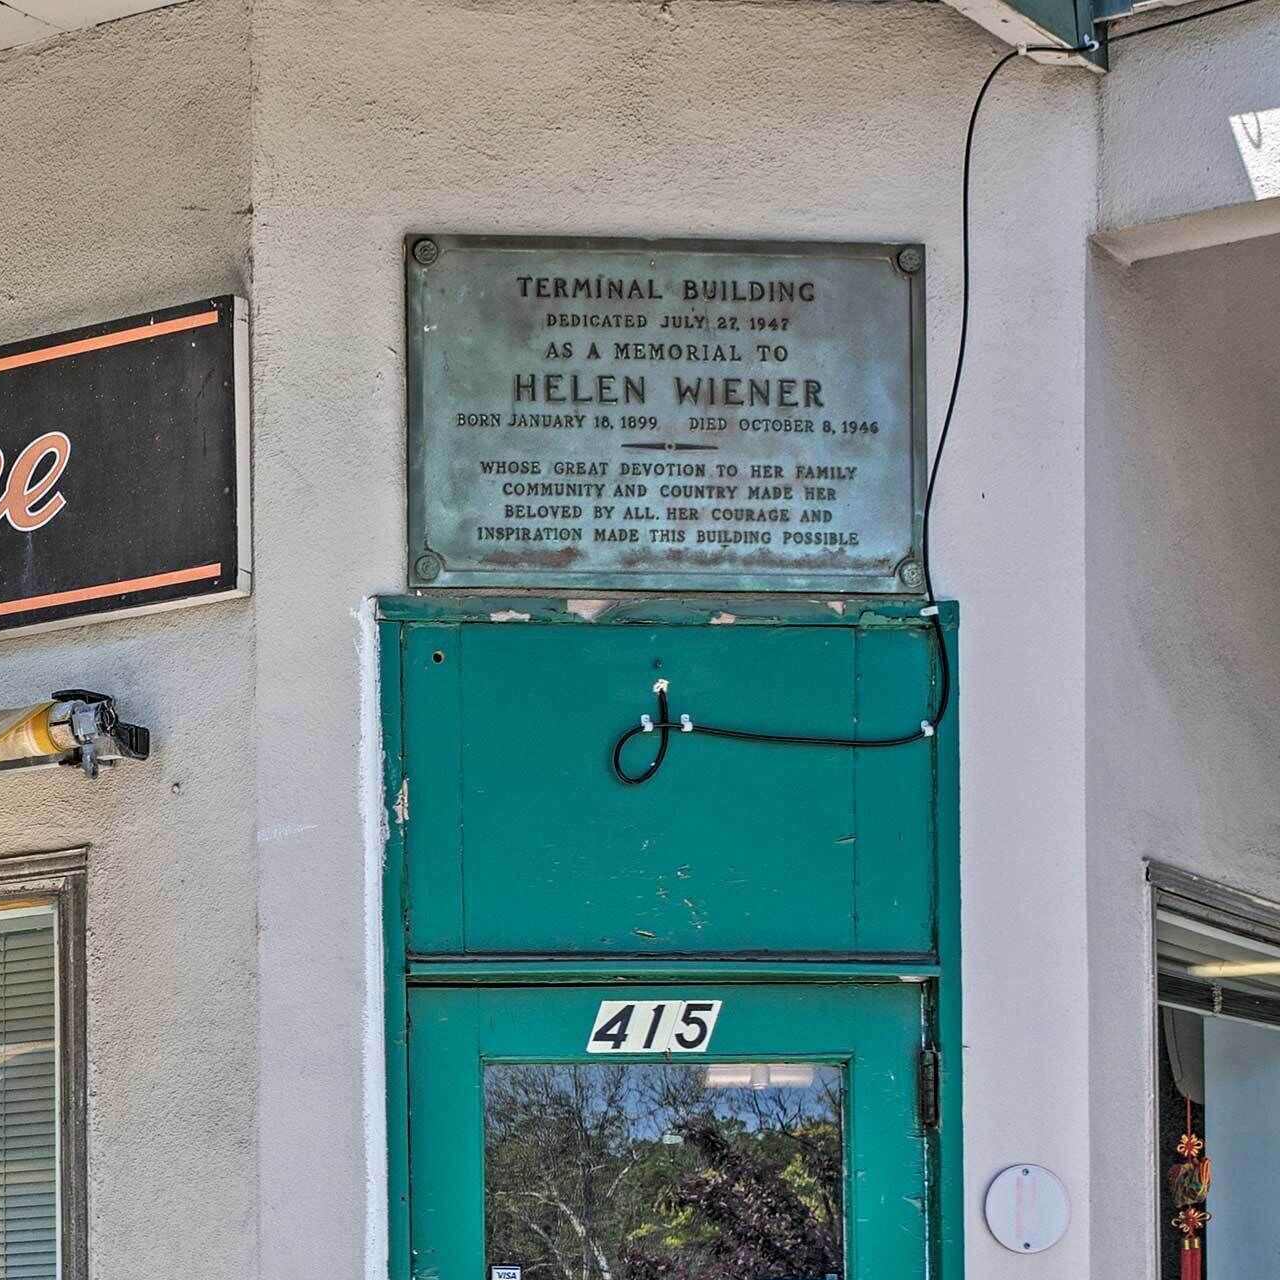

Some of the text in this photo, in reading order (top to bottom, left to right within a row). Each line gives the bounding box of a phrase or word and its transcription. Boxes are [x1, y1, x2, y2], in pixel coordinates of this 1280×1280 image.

[517, 277, 816, 302] TERMINAL BUILDING
[546, 314, 648, 328] DEDICATED
[659, 315, 705, 329] JULY
[750, 317, 790, 331] 1947
[546, 342, 789, 362] AS A MEMORIAL TO
[512, 373, 824, 408] HELEN WIENER
[456, 413, 501, 428] BORN
[508, 414, 586, 429] JANUARY
[621, 416, 658, 430] 1899
[689, 418, 727, 431] DIED
[740, 419, 814, 433] OCTOBER
[843, 421, 880, 434] 1946
[480, 461, 858, 480] WHOSE GREAT DEVOTION TO HER FAMILY
[502, 483, 837, 501] COMMUNITY AND COUNTRY MADE HER
[505, 505, 582, 519] BELOVED
[594, 506, 615, 520] BY
[666, 507, 699, 521] HER
[711, 508, 790, 523] COURAGE
[800, 509, 833, 523] AND
[477, 527, 859, 546] INSPIRATION MADE THIS BUILDING POSSIBLE
[592, 1003, 713, 1049] 415
